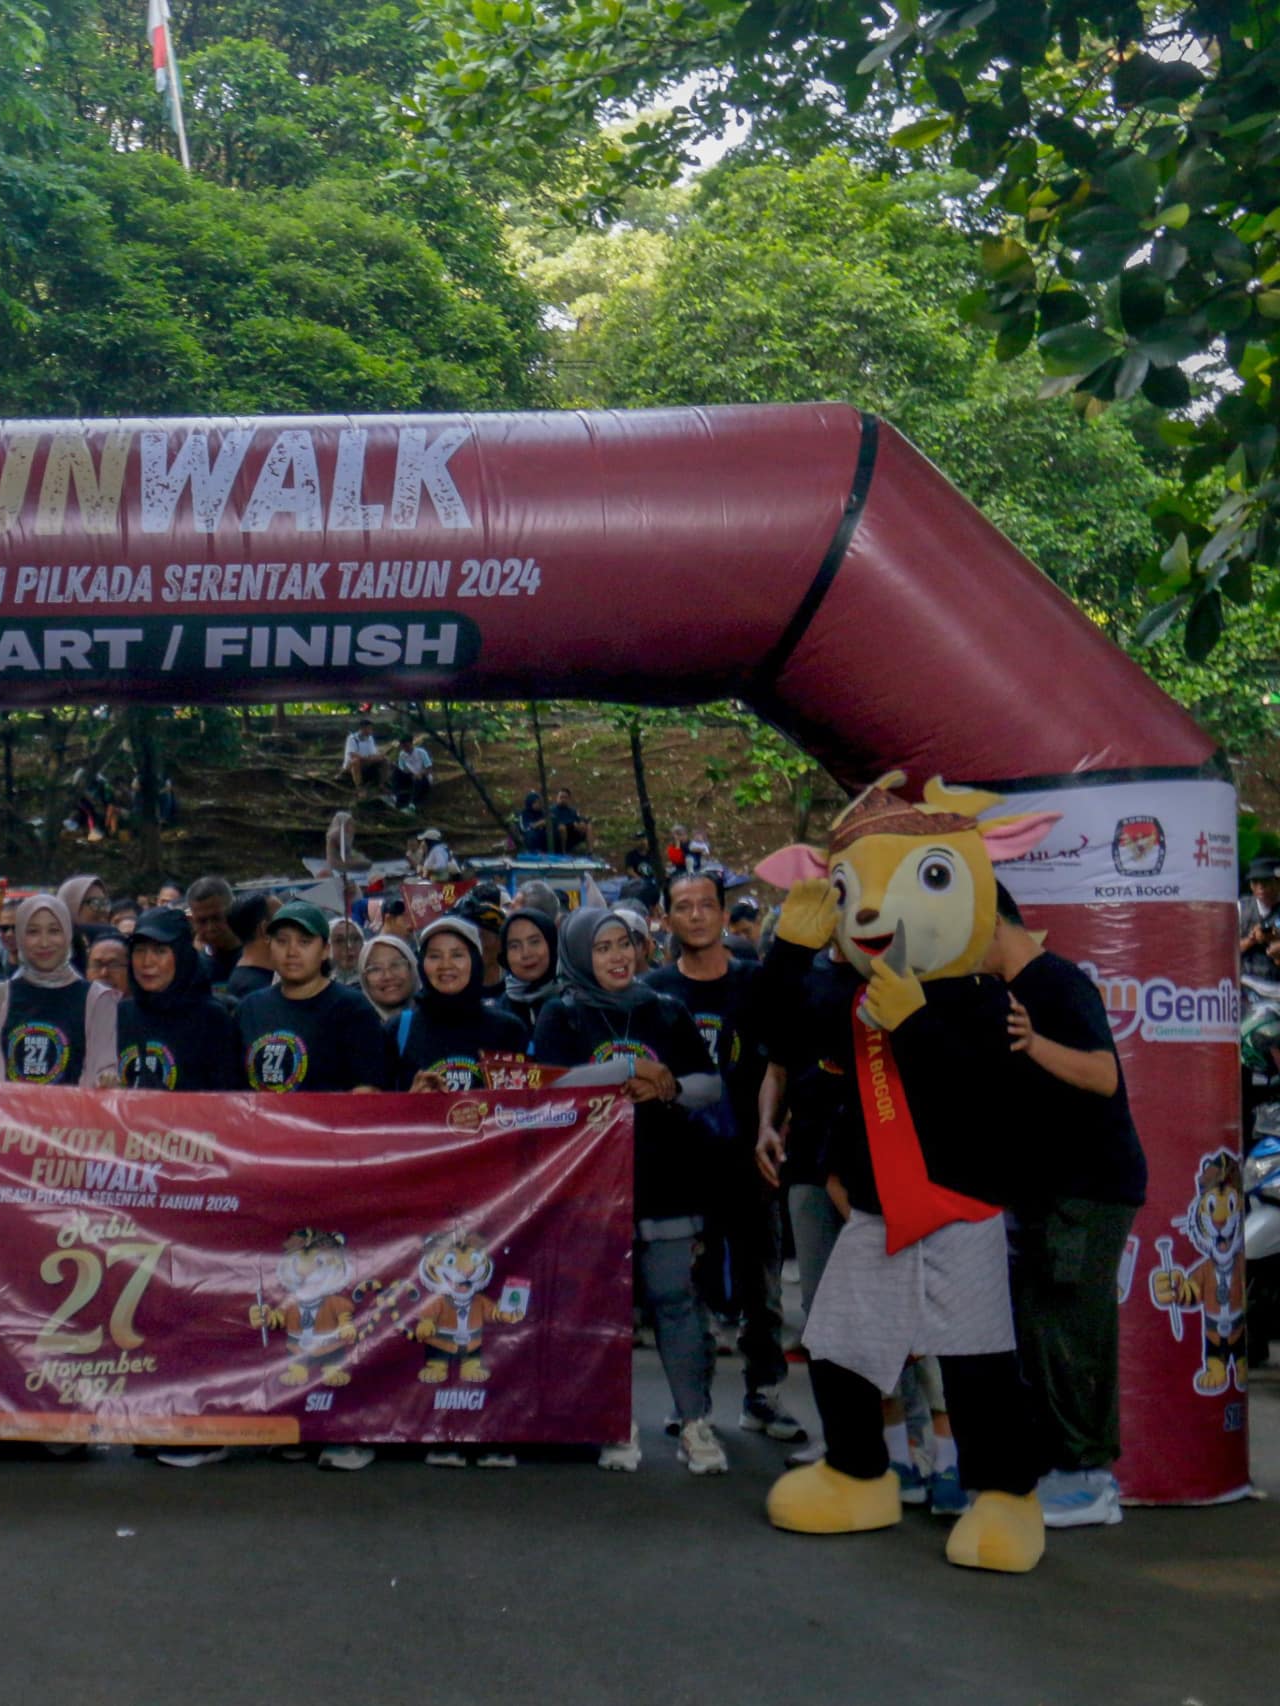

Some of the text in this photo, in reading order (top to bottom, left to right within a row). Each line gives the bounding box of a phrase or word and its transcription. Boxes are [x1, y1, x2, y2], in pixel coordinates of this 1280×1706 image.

[15, 565, 153, 604] PILKADA
[161, 562, 330, 602] SERENTAK
[336, 560, 451, 599] TAHUN
[457, 557, 541, 598] 2024
[204, 623, 458, 669] FINISH
[1094, 885, 1181, 898] KOTA BOGOR
[1145, 984, 1240, 1024] Gemila
[24, 1046, 48, 1064] 27
[263, 1052, 284, 1069] 27
[586, 1095, 617, 1123] 27
[869, 1058, 896, 1124] BOGOR
[43, 1126, 117, 1158] KOTA
[123, 1130, 218, 1163] BOGOR
[92, 1191, 156, 1208] SERENTAK
[159, 1195, 204, 1210] TAHUN
[206, 1196, 240, 1212] 2024
[57, 1210, 138, 1248] Rabu
[35, 1241, 167, 1355] 27
[25, 1351, 158, 1392] November
[304, 1391, 334, 1412] SILI
[433, 1388, 487, 1411] WANGI
